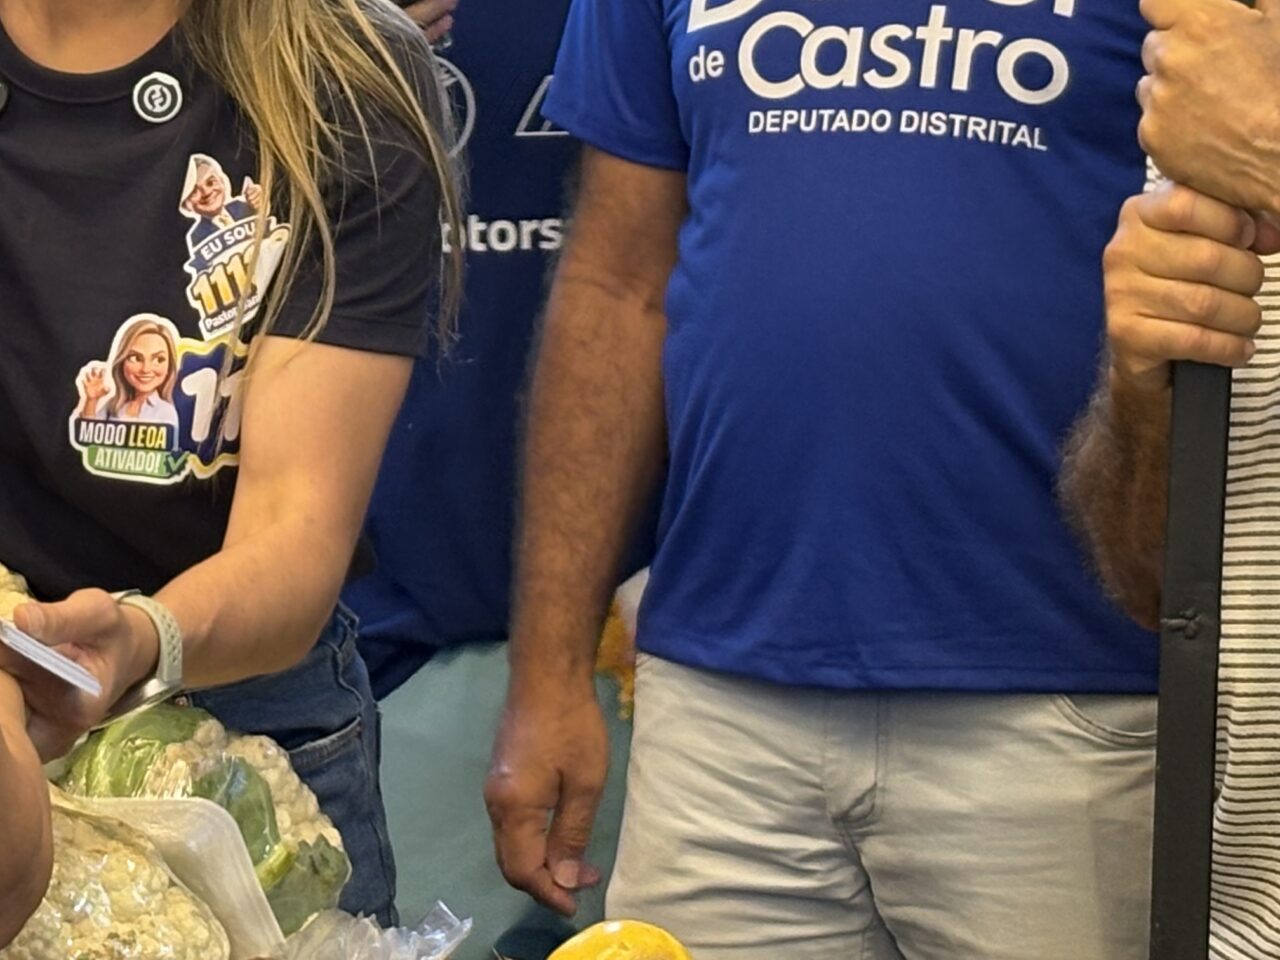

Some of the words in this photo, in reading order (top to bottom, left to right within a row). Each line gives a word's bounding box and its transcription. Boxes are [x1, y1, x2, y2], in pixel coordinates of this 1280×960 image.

[688, 45, 725, 83] de
[737, 4, 1069, 105] Castro
[748, 108, 892, 134] DEPUTADO
[899, 110, 1048, 151] DISTRITAL
[200, 238, 223, 261] EU
[223, 221, 257, 246] SOU
[79, 422, 127, 445] MODO
[129, 424, 168, 449] LEOA
[94, 447, 161, 473] ATIVADO!
